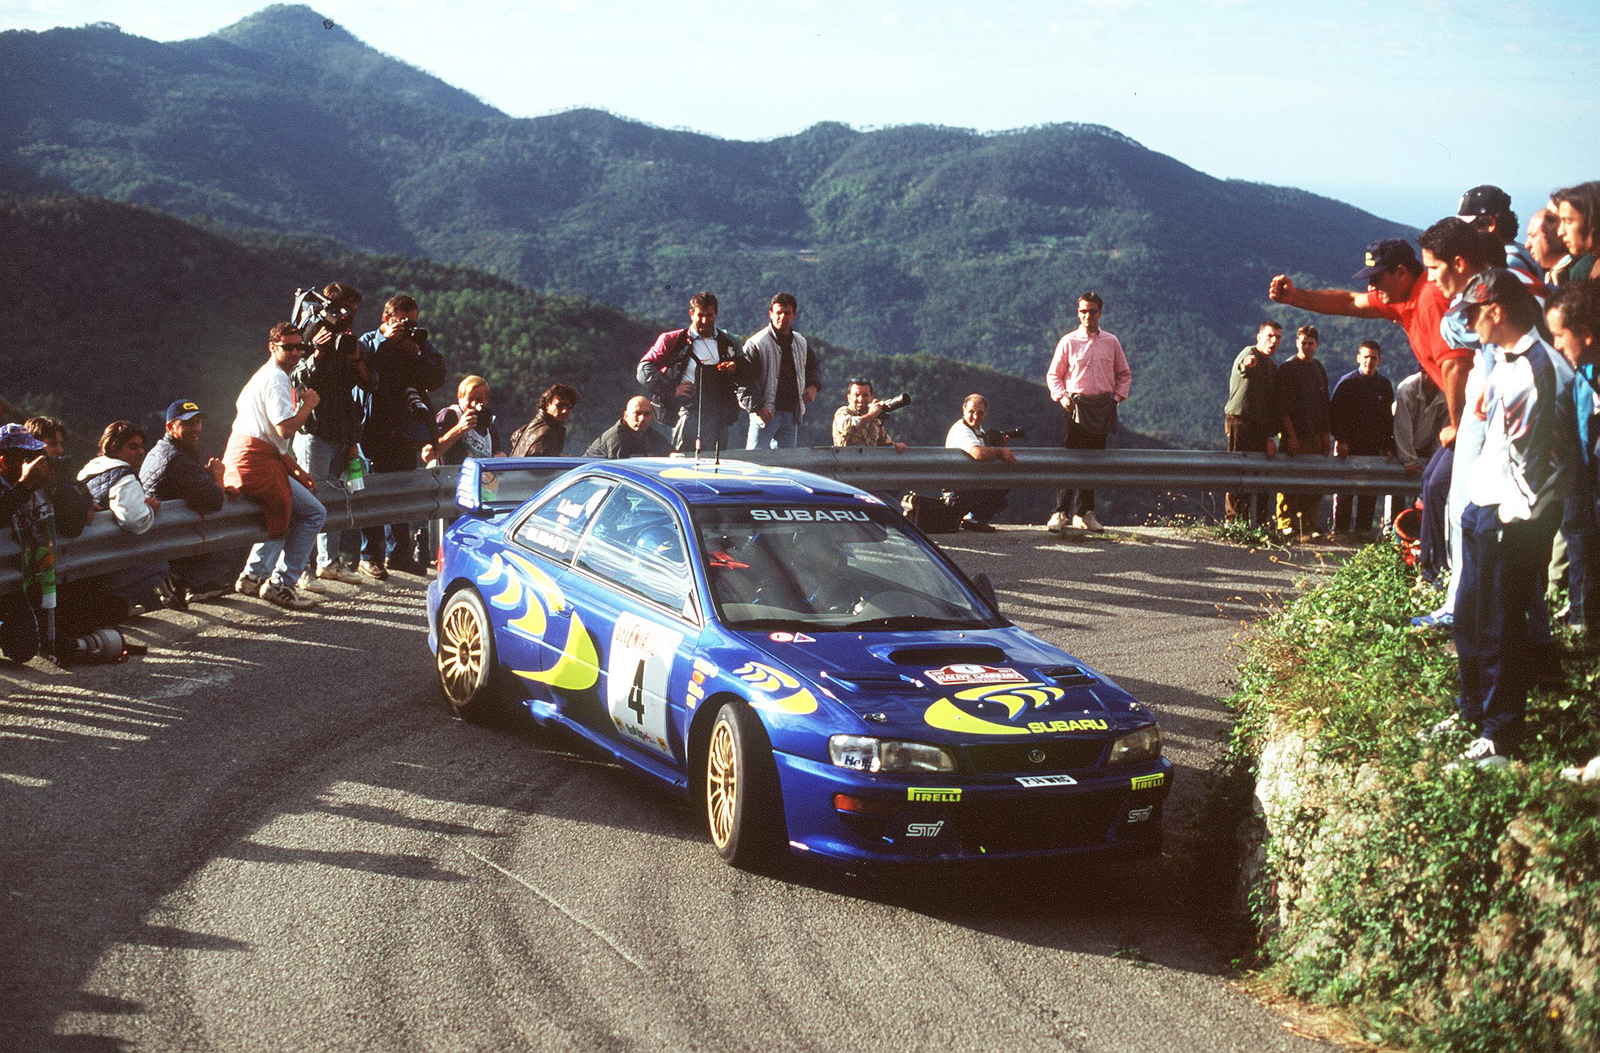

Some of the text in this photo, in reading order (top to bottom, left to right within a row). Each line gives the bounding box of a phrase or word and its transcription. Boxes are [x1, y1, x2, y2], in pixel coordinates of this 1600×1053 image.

[750, 509, 870, 521] SUBARU
[628, 659, 645, 725] 4
[1027, 719, 1108, 733] SUBARU
[1131, 772, 1164, 790] PIRELLI
[907, 787, 962, 801] PIRELLI
